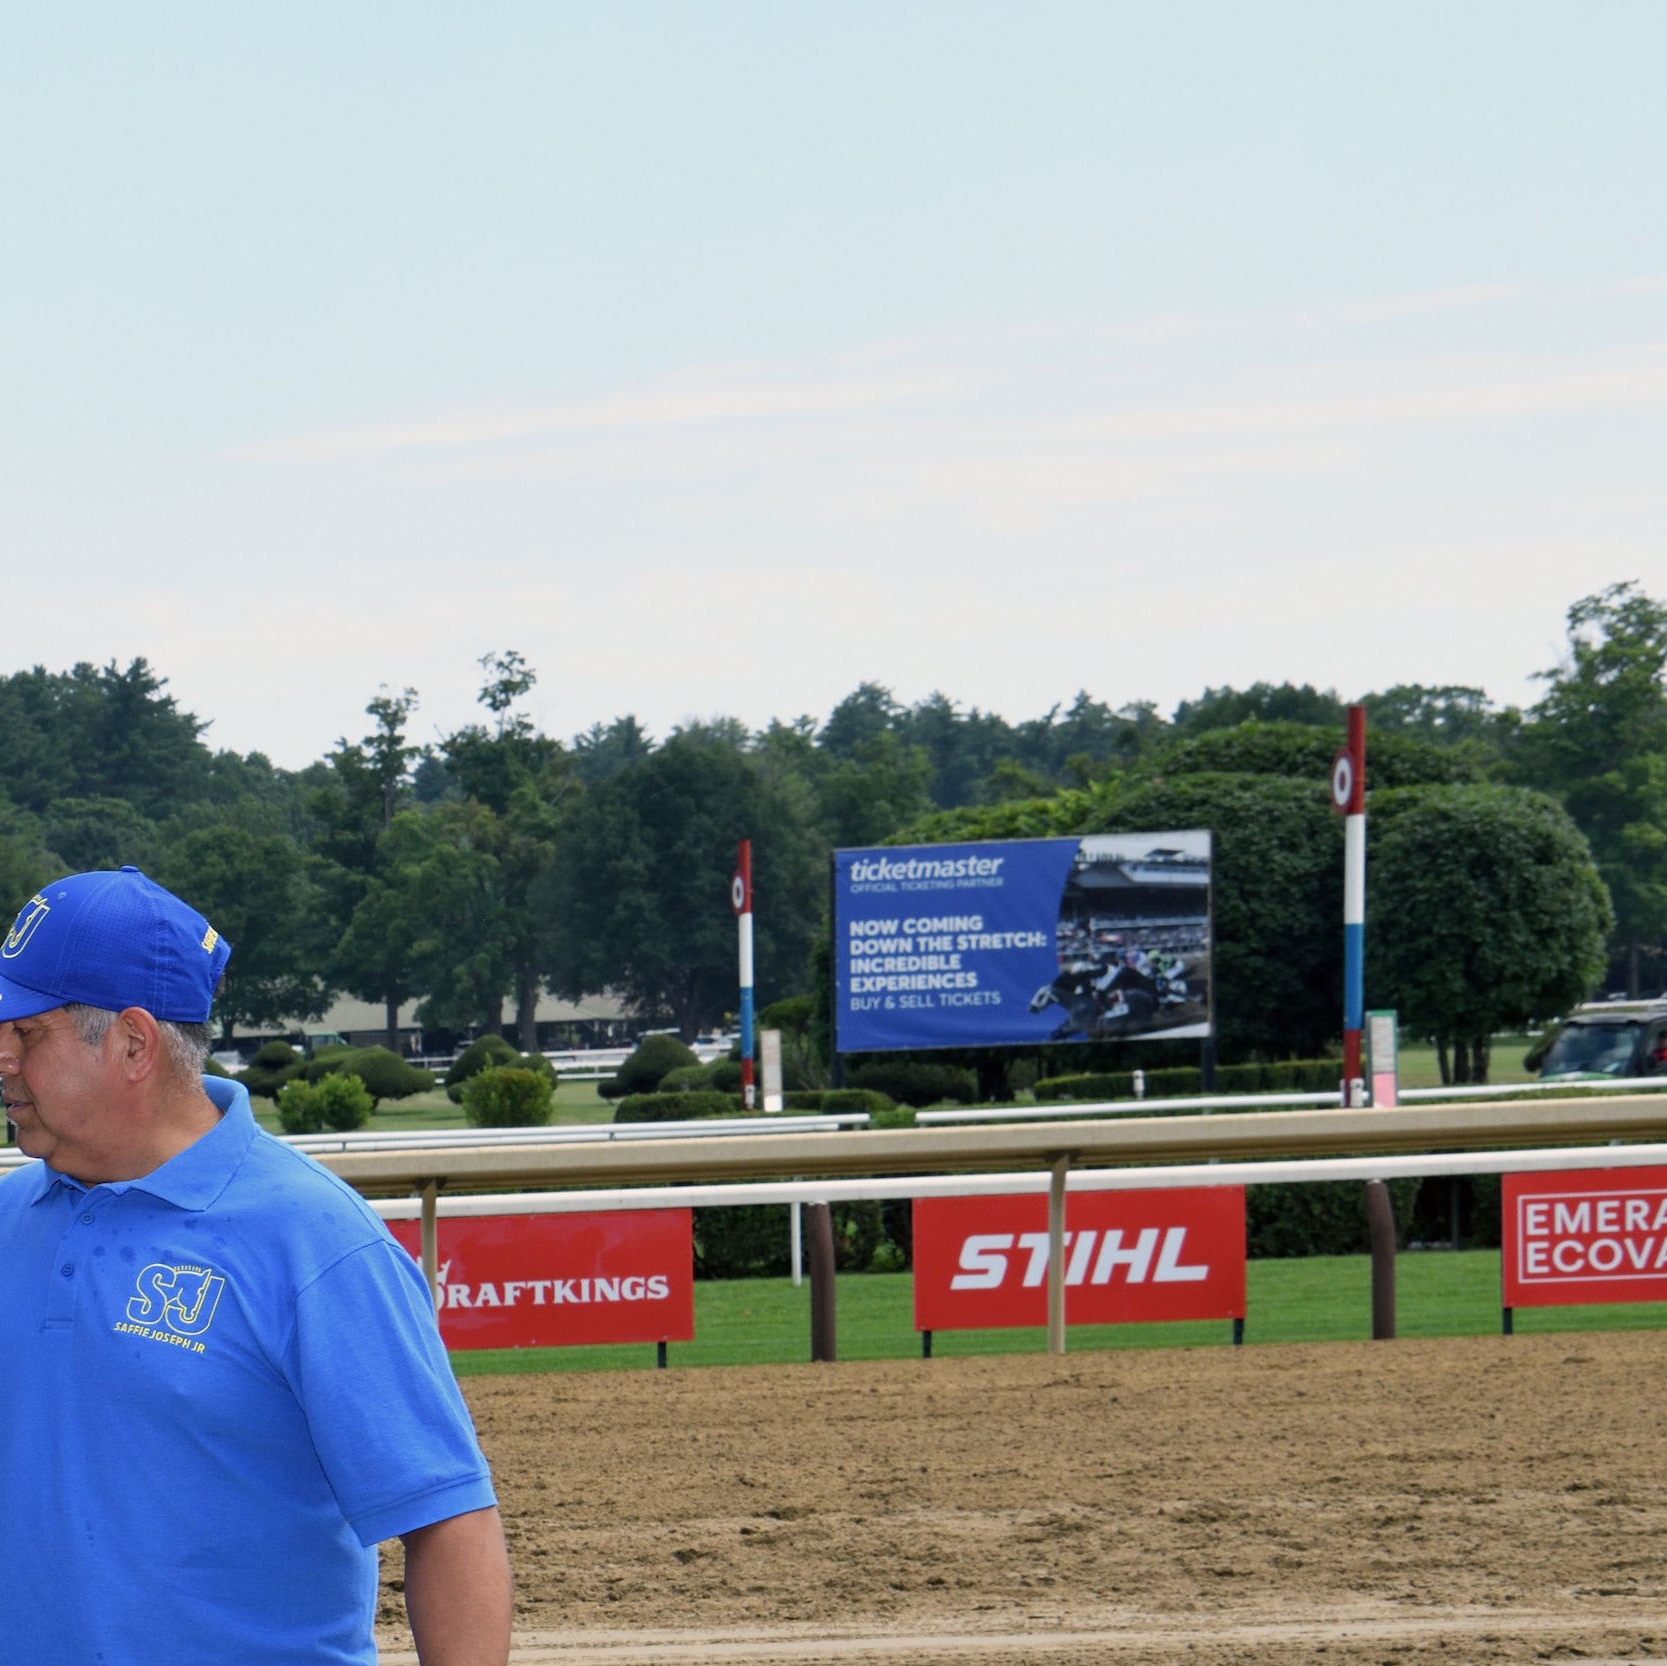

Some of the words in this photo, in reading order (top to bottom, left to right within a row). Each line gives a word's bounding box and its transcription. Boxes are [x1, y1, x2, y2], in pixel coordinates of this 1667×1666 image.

[850, 855, 1004, 882] ticketmaster
[850, 882, 897, 894] OFFICIAL
[901, 879, 955, 891] TICKETING
[957, 877, 1004, 888] PARTNER
[849, 919, 898, 936] NOW
[902, 916, 983, 934] COMING
[850, 938, 912, 955] DOWN
[917, 936, 953, 952] THE
[957, 931, 1047, 950] STRETCH:
[850, 954, 961, 974] INCREDIBLE
[850, 972, 978, 993] EXPERIENCES
[850, 996, 881, 1011] BUY
[884, 996, 895, 1009] &
[899, 994, 934, 1008] SELL
[938, 991, 1002, 1006] TICKETS
[950, 1227, 1209, 1290] STIHL
[113, 1321, 151, 1338] SAFFIE
[148, 1330, 192, 1349] JOSEPH
[190, 1341, 206, 1354] JR
